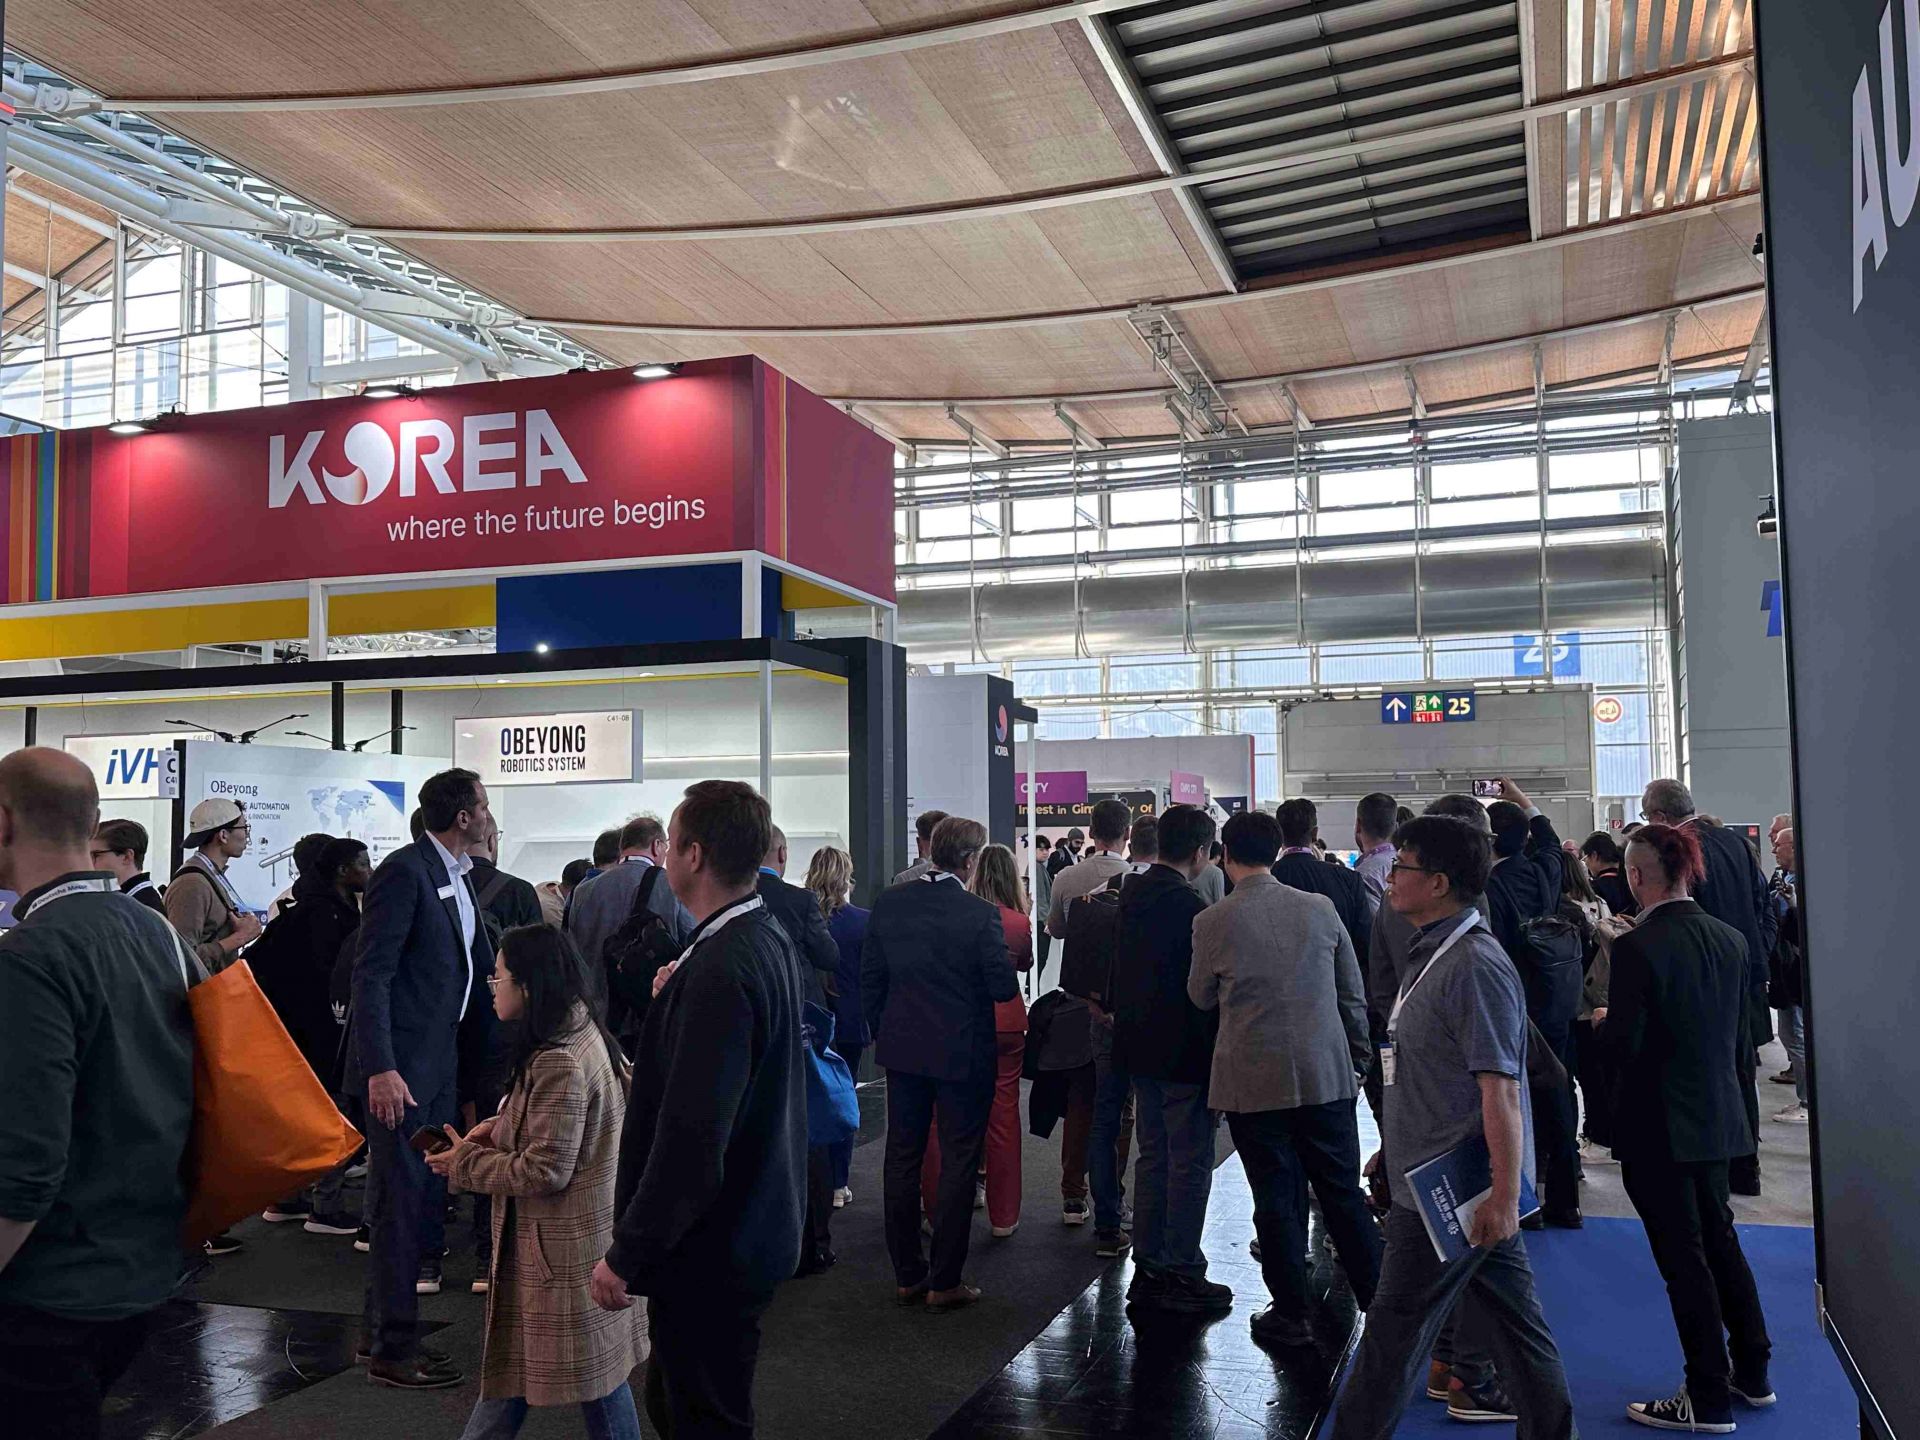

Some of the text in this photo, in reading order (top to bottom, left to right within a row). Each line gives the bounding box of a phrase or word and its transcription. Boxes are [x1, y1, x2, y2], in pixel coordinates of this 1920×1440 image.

[268, 408, 588, 509] KOREA
[387, 494, 705, 541] where the future begins
[1448, 698, 1470, 715] 25
[501, 724, 586, 756] OBEYONG
[167, 758, 176, 773] C
[501, 756, 586, 773] ROBOTICS SYSTEM
[210, 780, 258, 796] OBeyong
[1020, 782, 1048, 793] CTY
[249, 802, 290, 811] AUTOMATION
[1018, 804, 1054, 815] Inest
[1057, 805, 1067, 815] in
